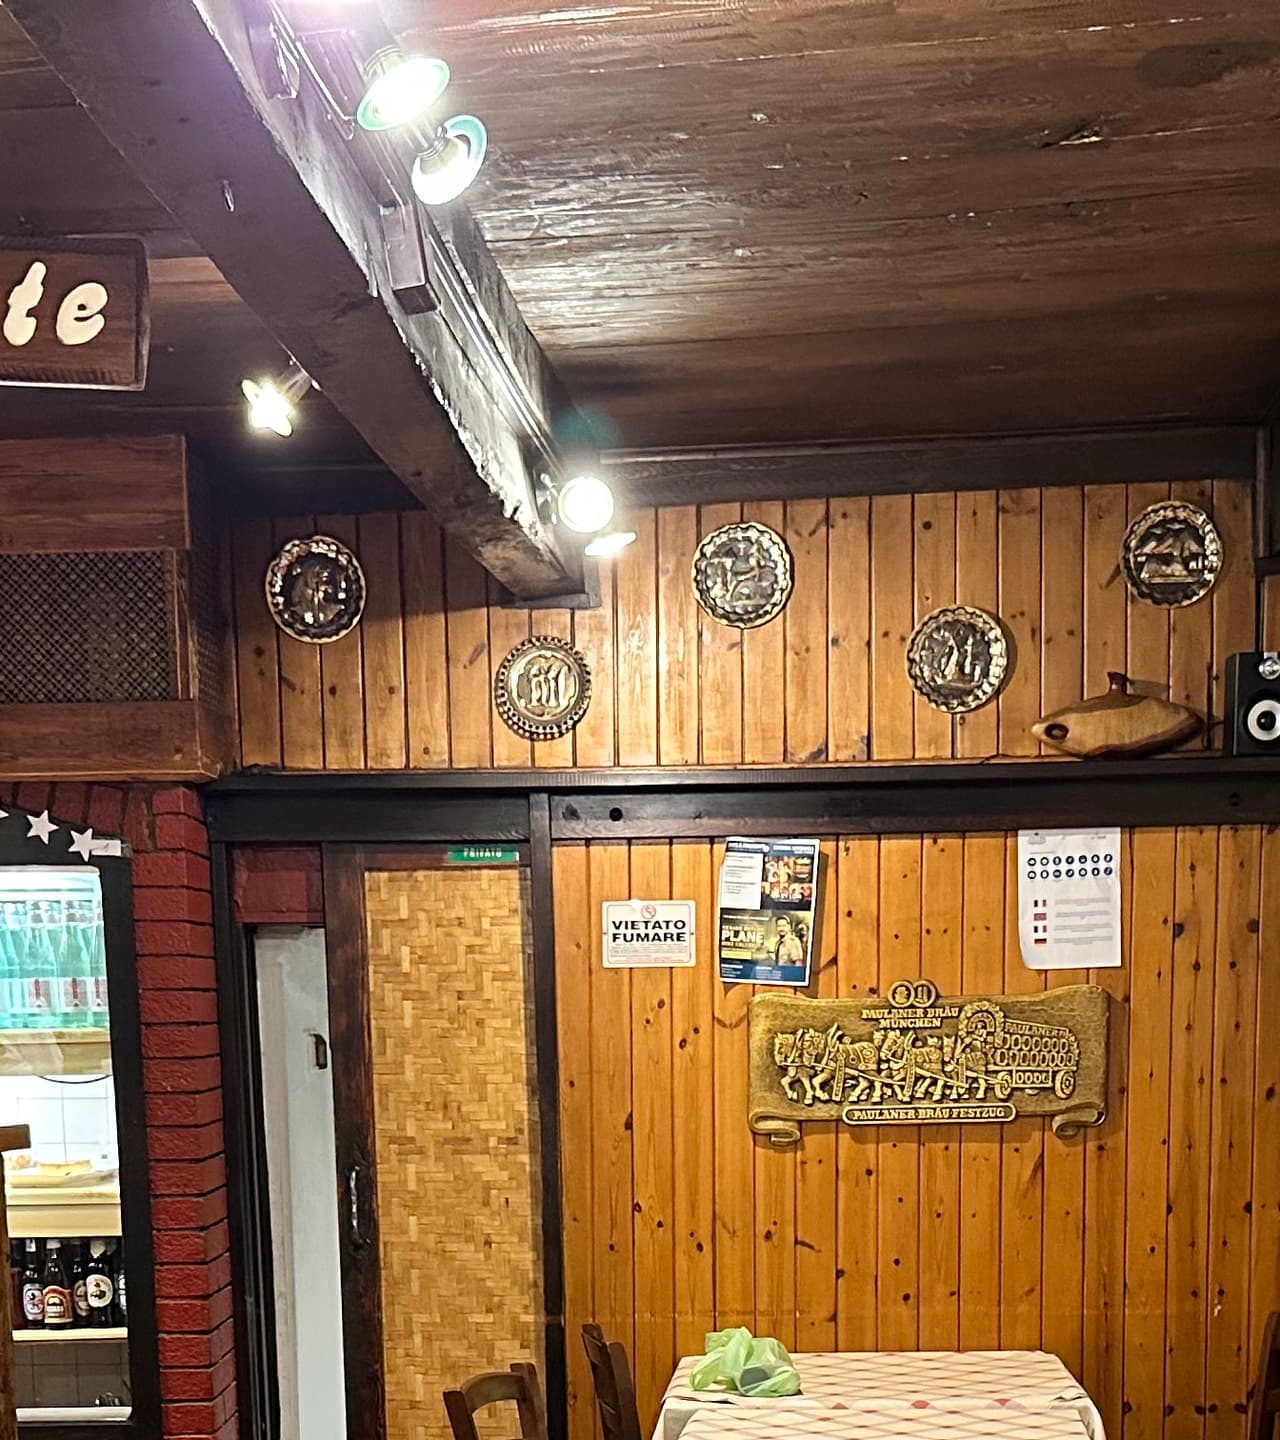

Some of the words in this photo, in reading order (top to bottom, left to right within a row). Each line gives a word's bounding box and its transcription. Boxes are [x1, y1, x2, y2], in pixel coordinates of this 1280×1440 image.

[463, 847, 502, 858] PRIVATO
[611, 919, 687, 931] VIETATO
[611, 932, 687, 943] FUMARE
[722, 930, 765, 944] PLANE
[861, 1008, 924, 1018] PAULANER
[1004, 1022, 1058, 1037] PAULANER
